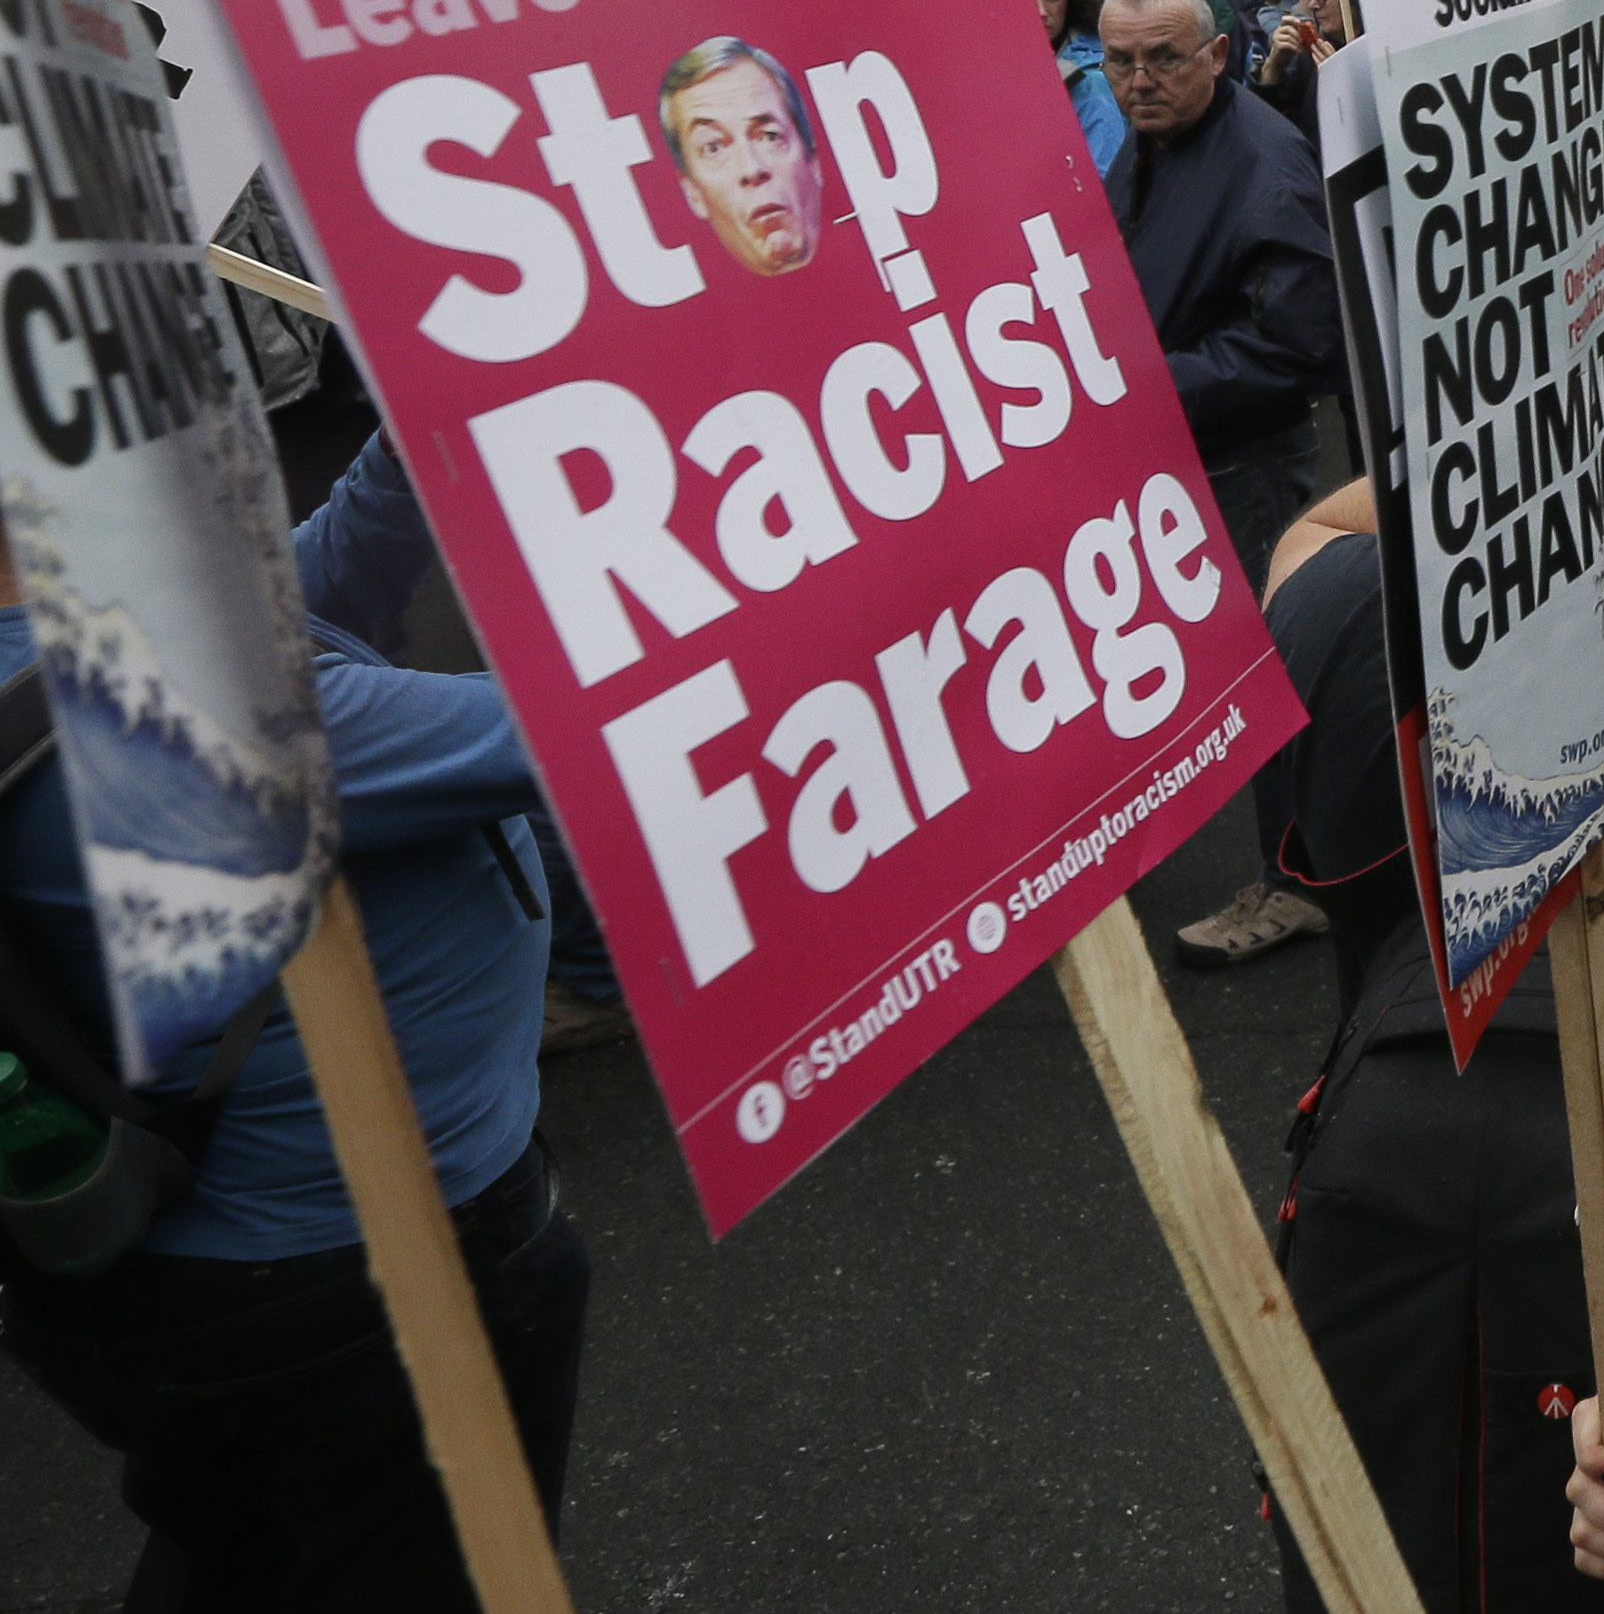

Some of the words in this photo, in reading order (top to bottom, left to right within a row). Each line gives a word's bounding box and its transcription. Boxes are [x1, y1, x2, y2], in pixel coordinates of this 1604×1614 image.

[1422, 270, 1556, 428] NOT
[1563, 268, 1586, 307] One
[468, 211, 1128, 691] Racist
[600, 472, 1223, 990] Farage
[1006, 703, 1246, 923] standuptoracism.org.uk
[783, 937, 962, 1101] @StandUTR
